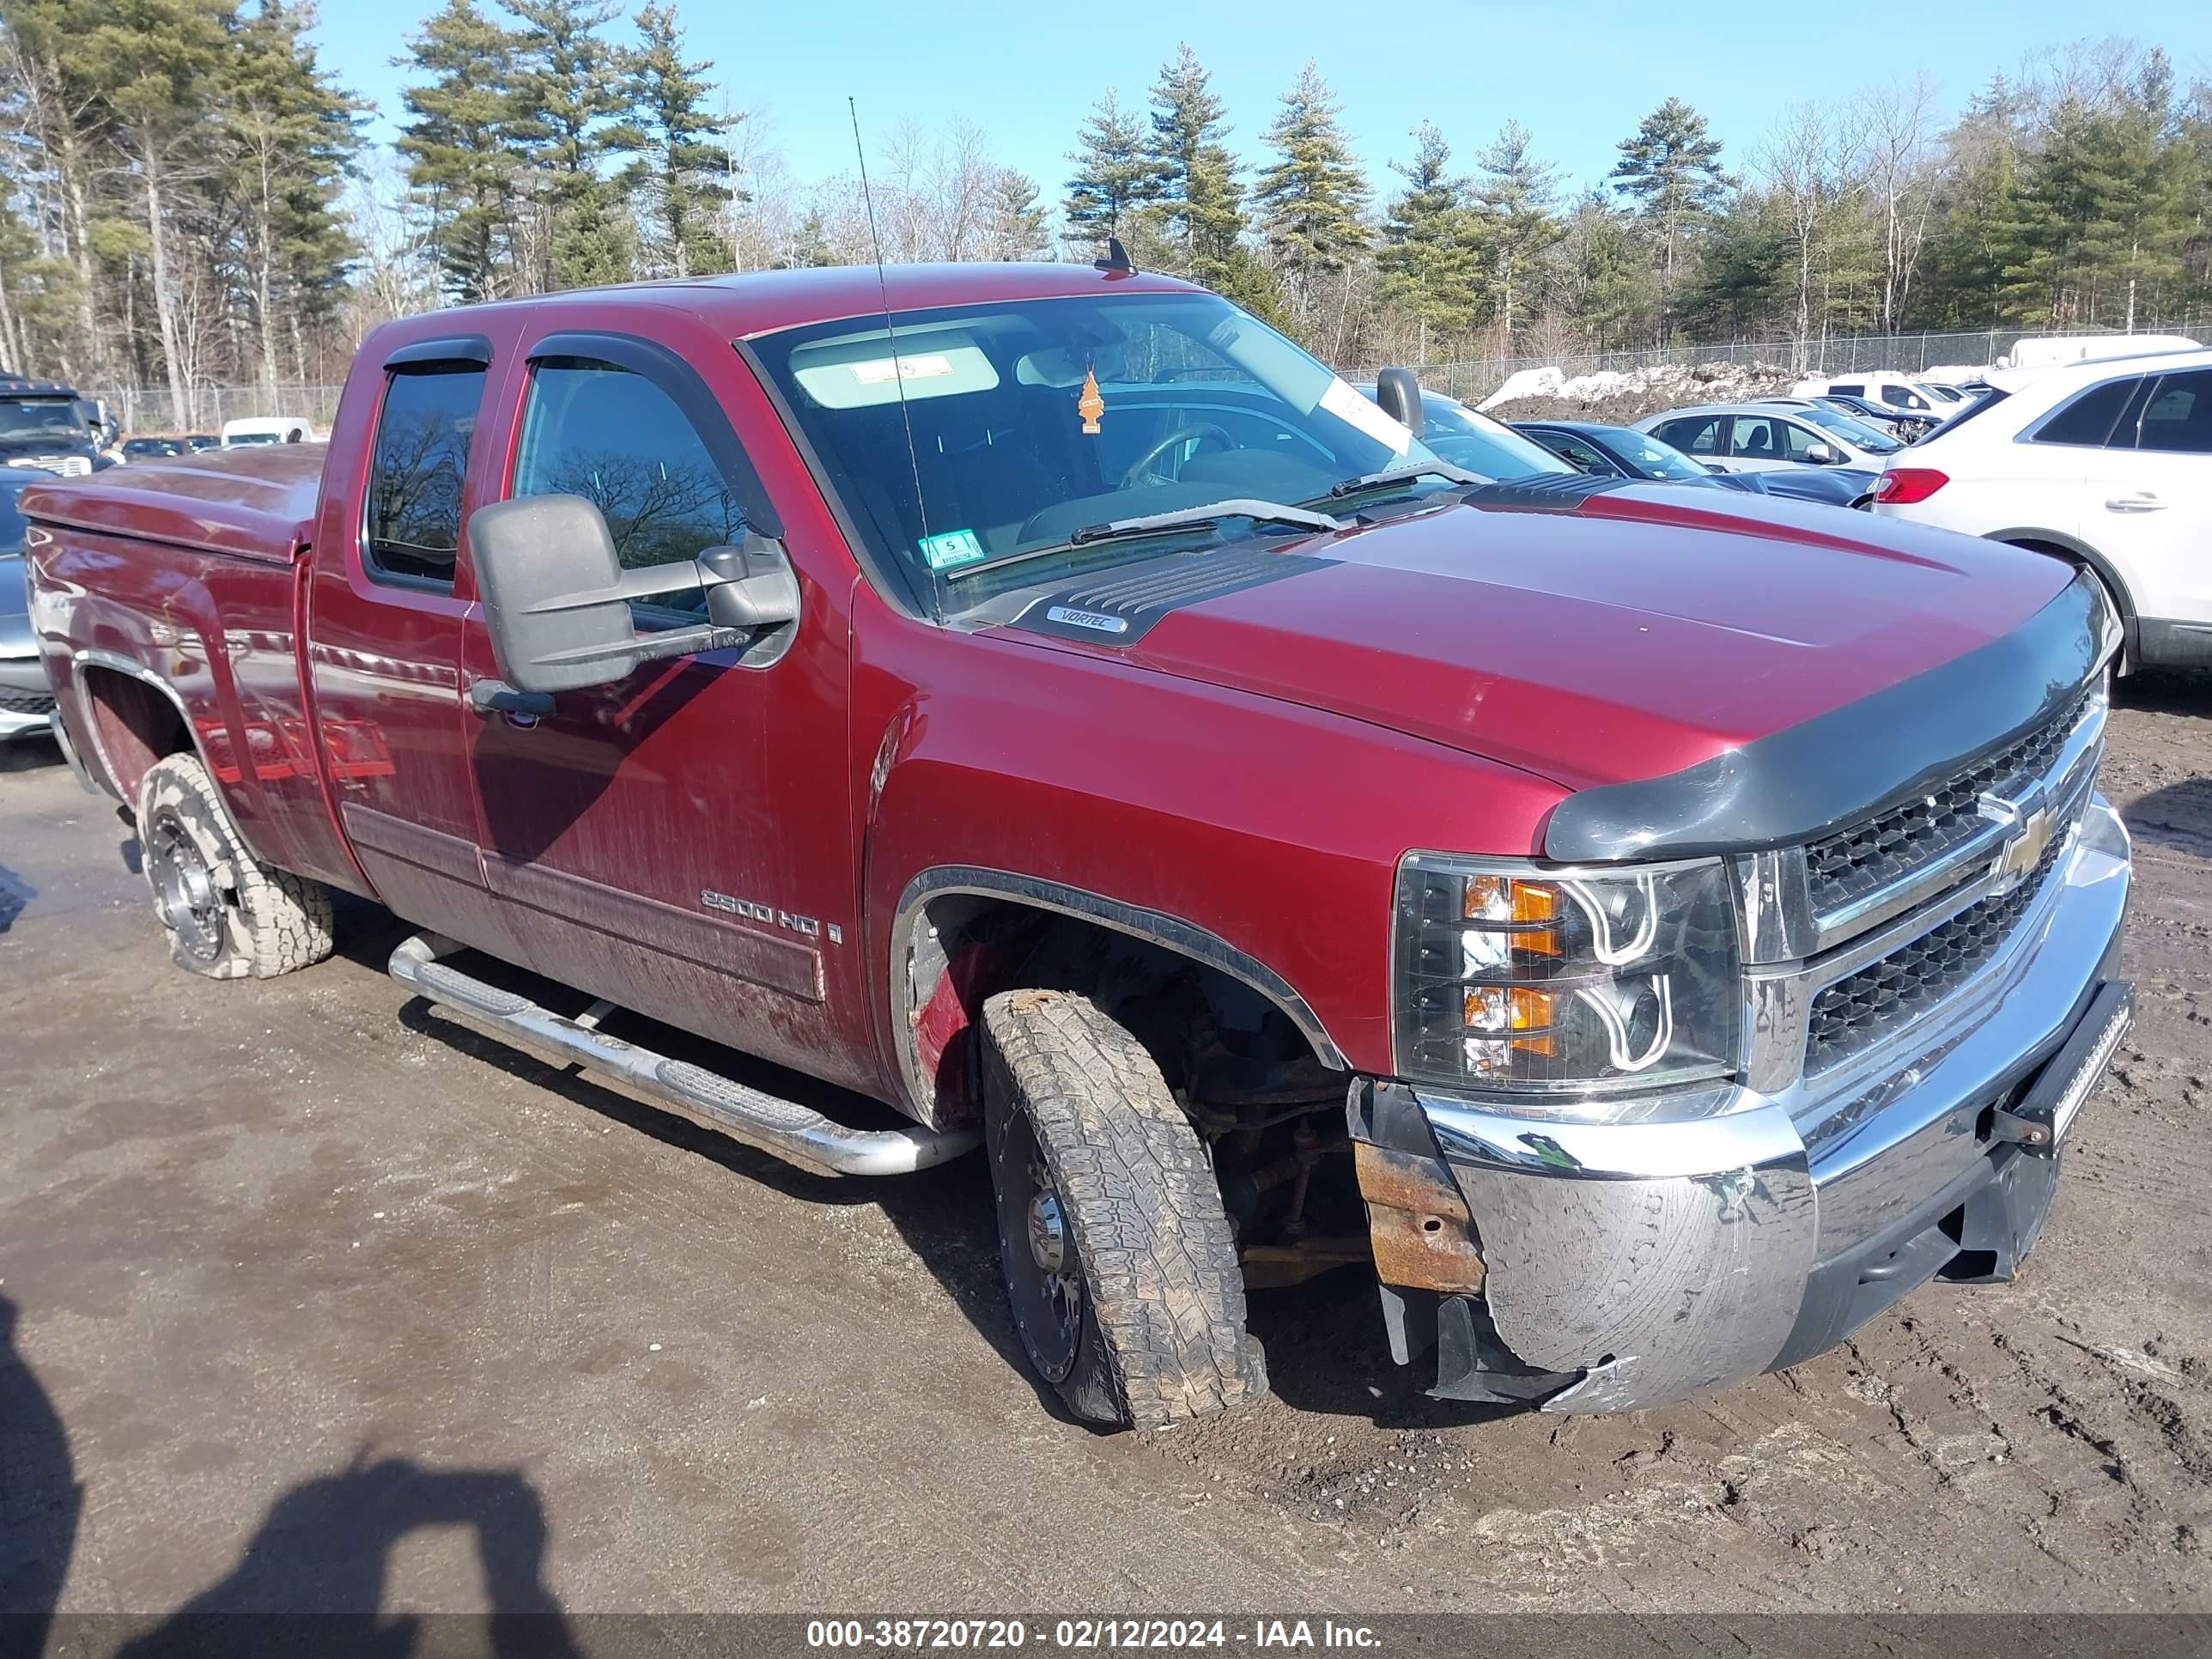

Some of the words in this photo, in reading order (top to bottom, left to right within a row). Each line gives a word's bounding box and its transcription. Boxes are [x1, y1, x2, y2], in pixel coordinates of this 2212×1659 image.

[1061, 610, 1112, 628] VORTEC
[701, 888, 773, 925] 2500
[777, 909, 819, 938] HD
